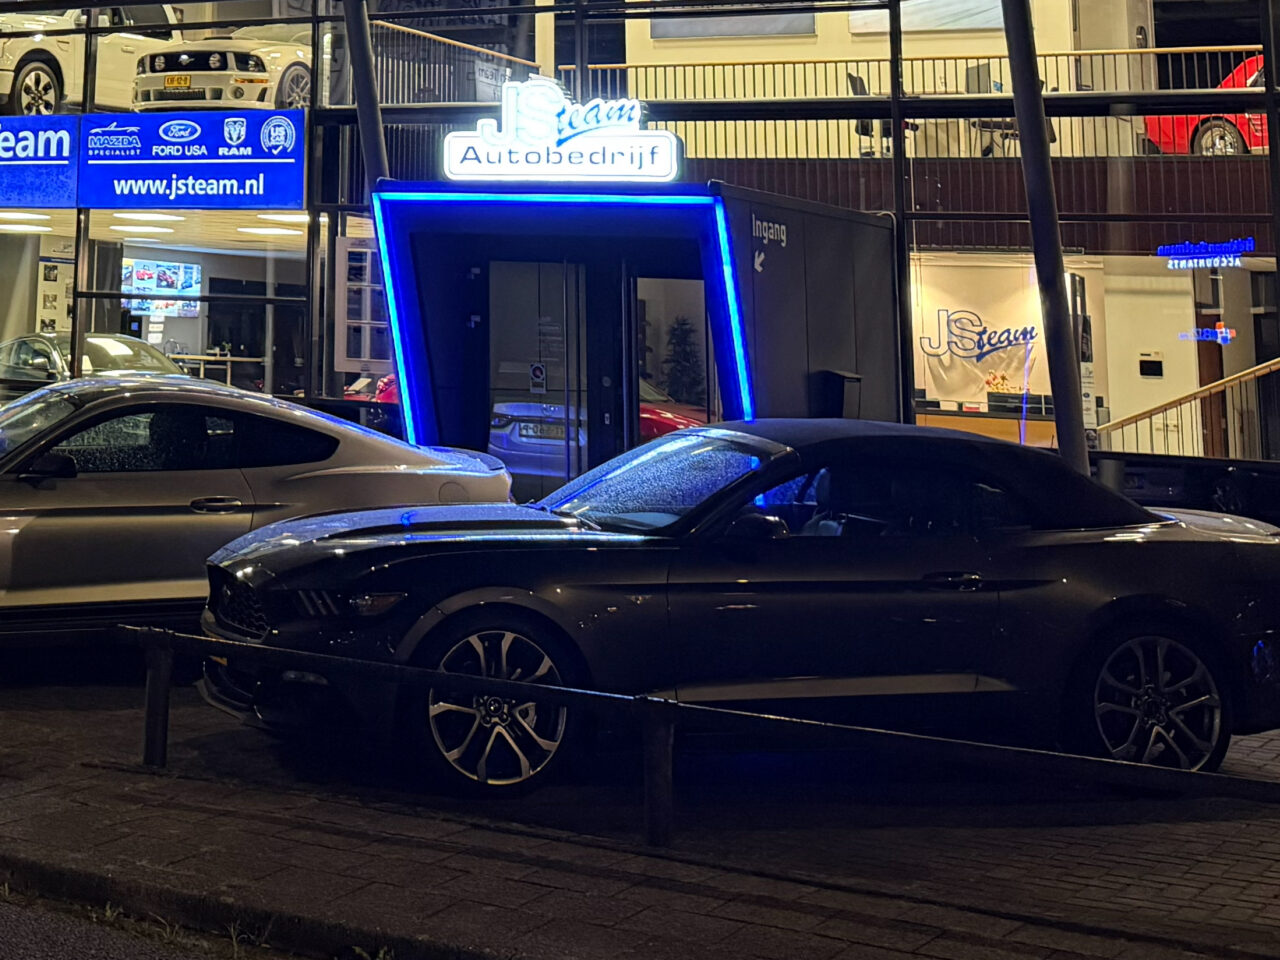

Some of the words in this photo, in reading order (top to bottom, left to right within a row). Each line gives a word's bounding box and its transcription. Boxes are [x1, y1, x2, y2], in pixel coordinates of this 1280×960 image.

[167, 125, 192, 138] Ford
[88, 136, 142, 148] MAZDA
[152, 145, 183, 156] FORD
[185, 145, 208, 156] USA
[218, 147, 252, 156] RAM
[459, 145, 660, 171] Autobedrijf
[113, 173, 264, 200] www.jsteam.nl
[752, 213, 787, 247] Ingang
